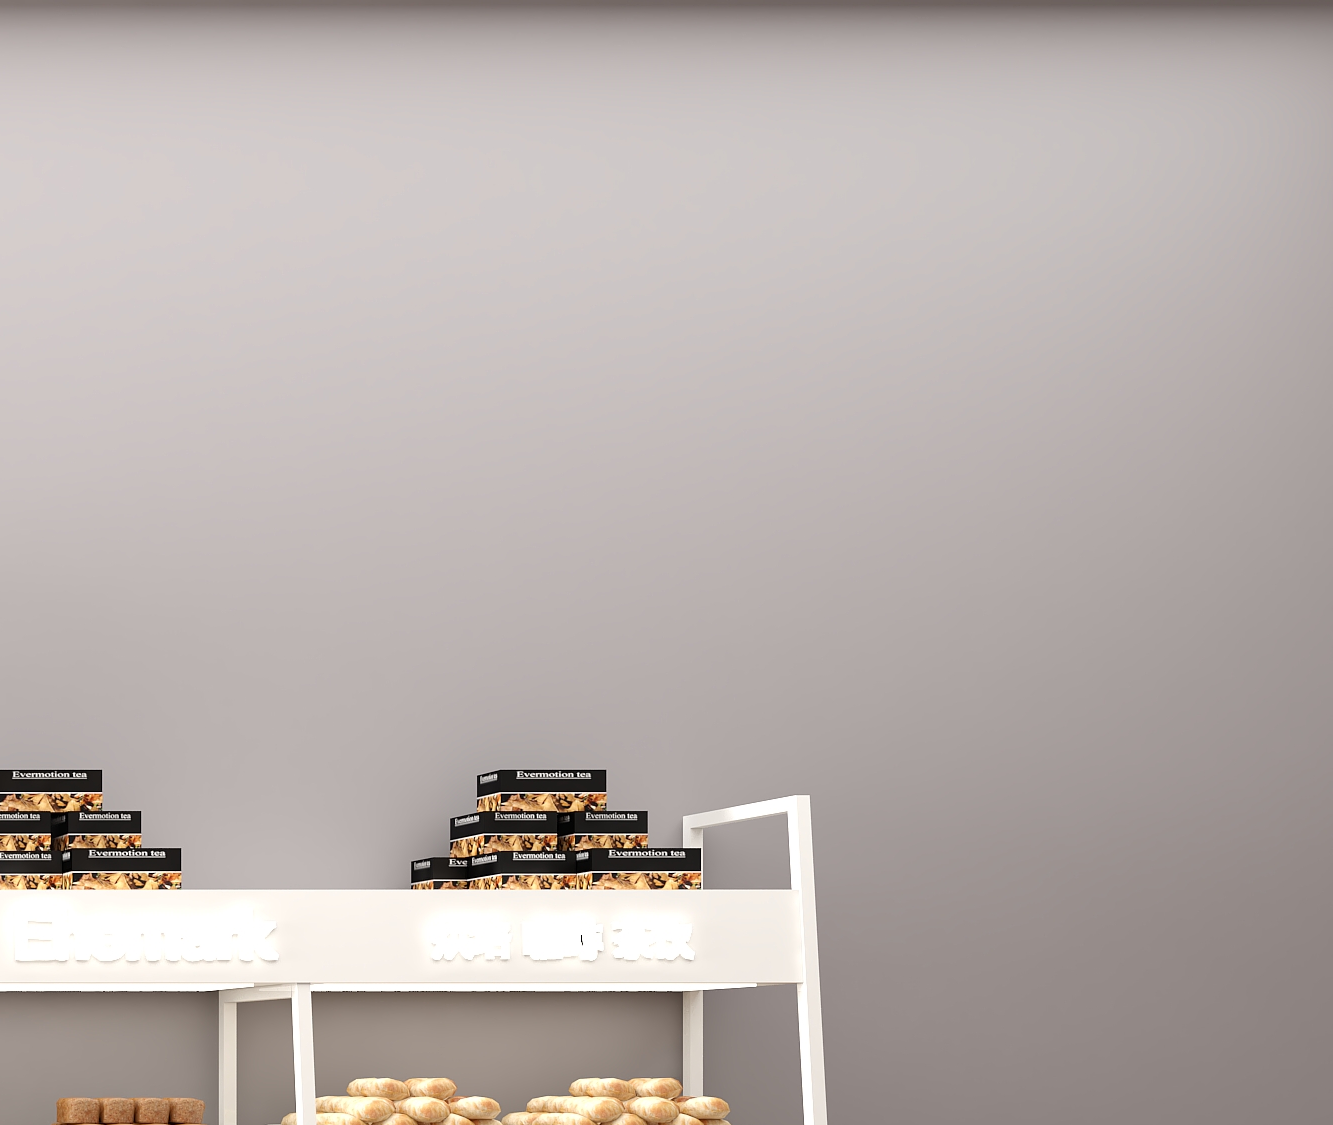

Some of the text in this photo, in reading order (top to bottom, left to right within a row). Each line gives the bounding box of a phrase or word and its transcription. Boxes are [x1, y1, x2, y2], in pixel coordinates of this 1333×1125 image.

[31, 812, 40, 820] tea
[79, 812, 131, 820] Evermotion tea
[495, 812, 547, 820] Evermotion tea
[585, 812, 638, 820] Evermotion tea
